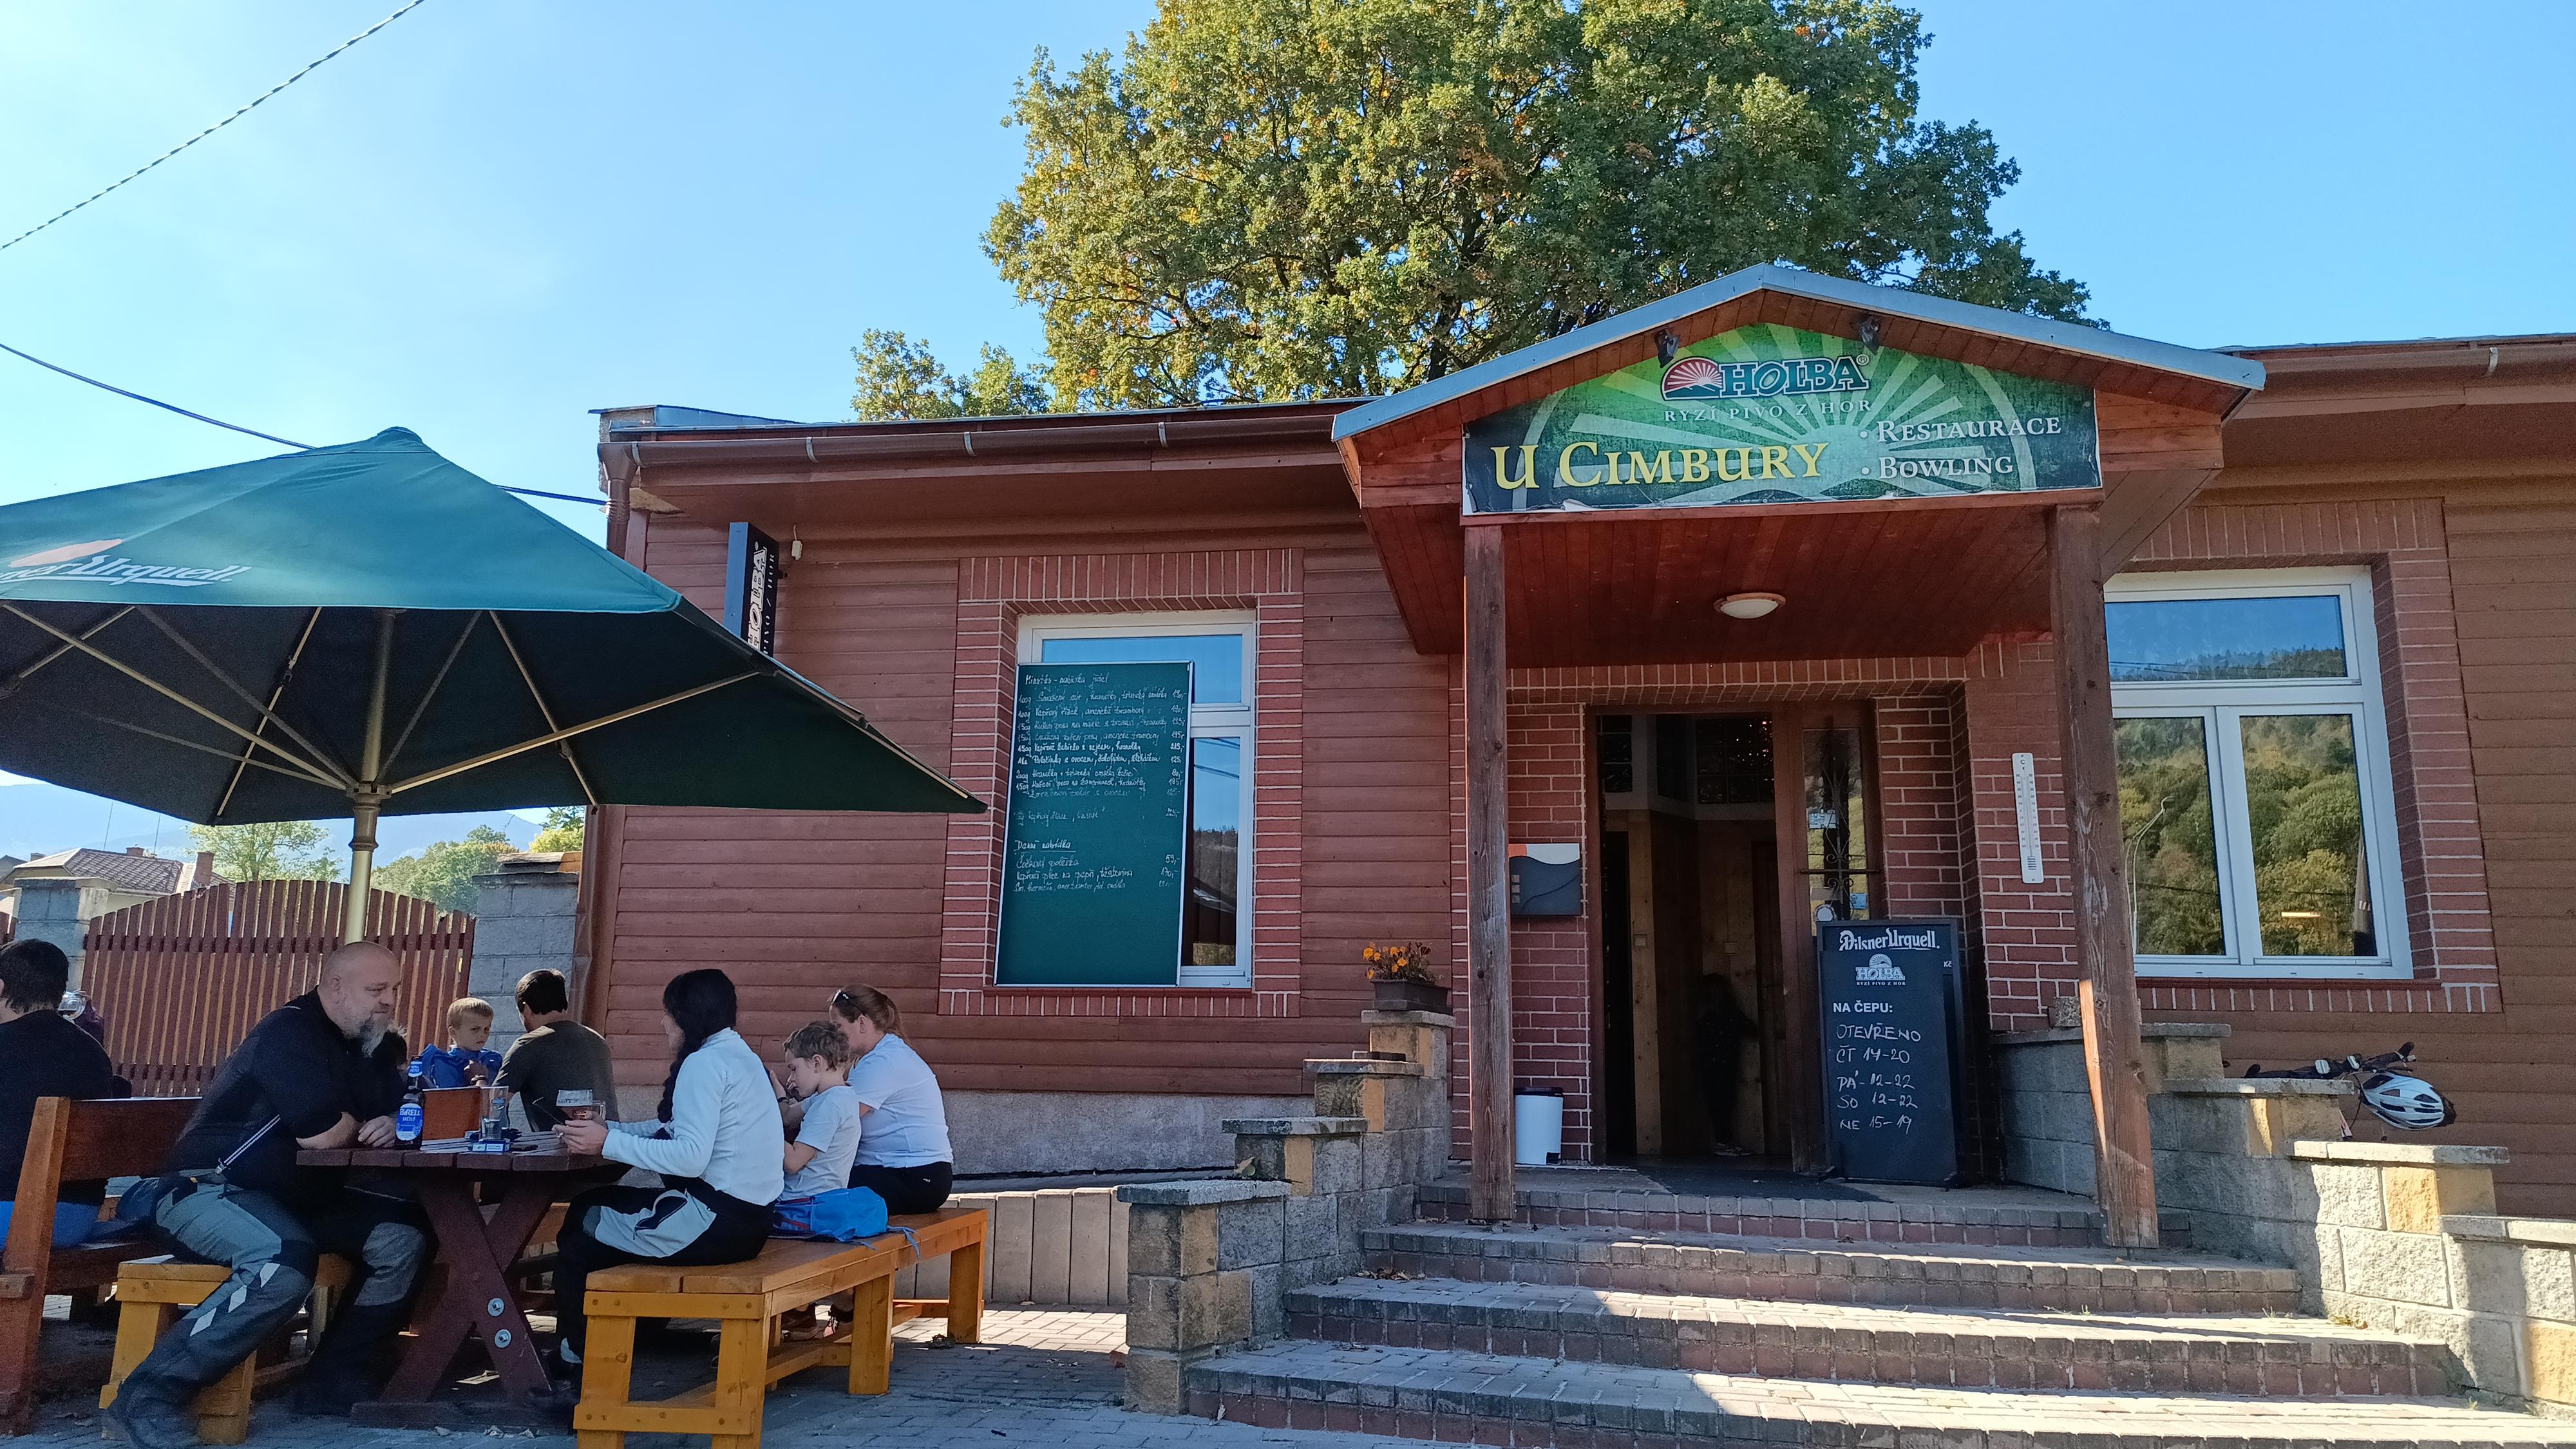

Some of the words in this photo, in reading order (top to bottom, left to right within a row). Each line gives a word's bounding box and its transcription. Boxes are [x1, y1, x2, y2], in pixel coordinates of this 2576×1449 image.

[1665, 408, 1716, 422] RYZÍ
[1730, 406, 1783, 419] PIVO
[1795, 404, 1808, 416] Z
[1821, 400, 1871, 414] HOR
[1877, 417, 2061, 443] RESTAURACE
[1491, 444, 1540, 489] U
[1558, 442, 1829, 488] CIMBURY
[1879, 457, 2014, 479] BOWLING
[748, 546, 768, 650] HOLBA
[1041, 838, 1072, 849] nabídka
[1839, 930, 1888, 951] Pilsner
[1855, 967, 1906, 981] HOLBA
[1833, 1003, 1851, 1012] NA
[1854, 999, 1893, 1013] ČEPU:
[1837, 1023, 1921, 1042] OTEVŘENO
[1836, 1045, 1857, 1063] ČT
[1837, 1094, 1858, 1108] SO
[1839, 1119, 1861, 1130] NE
